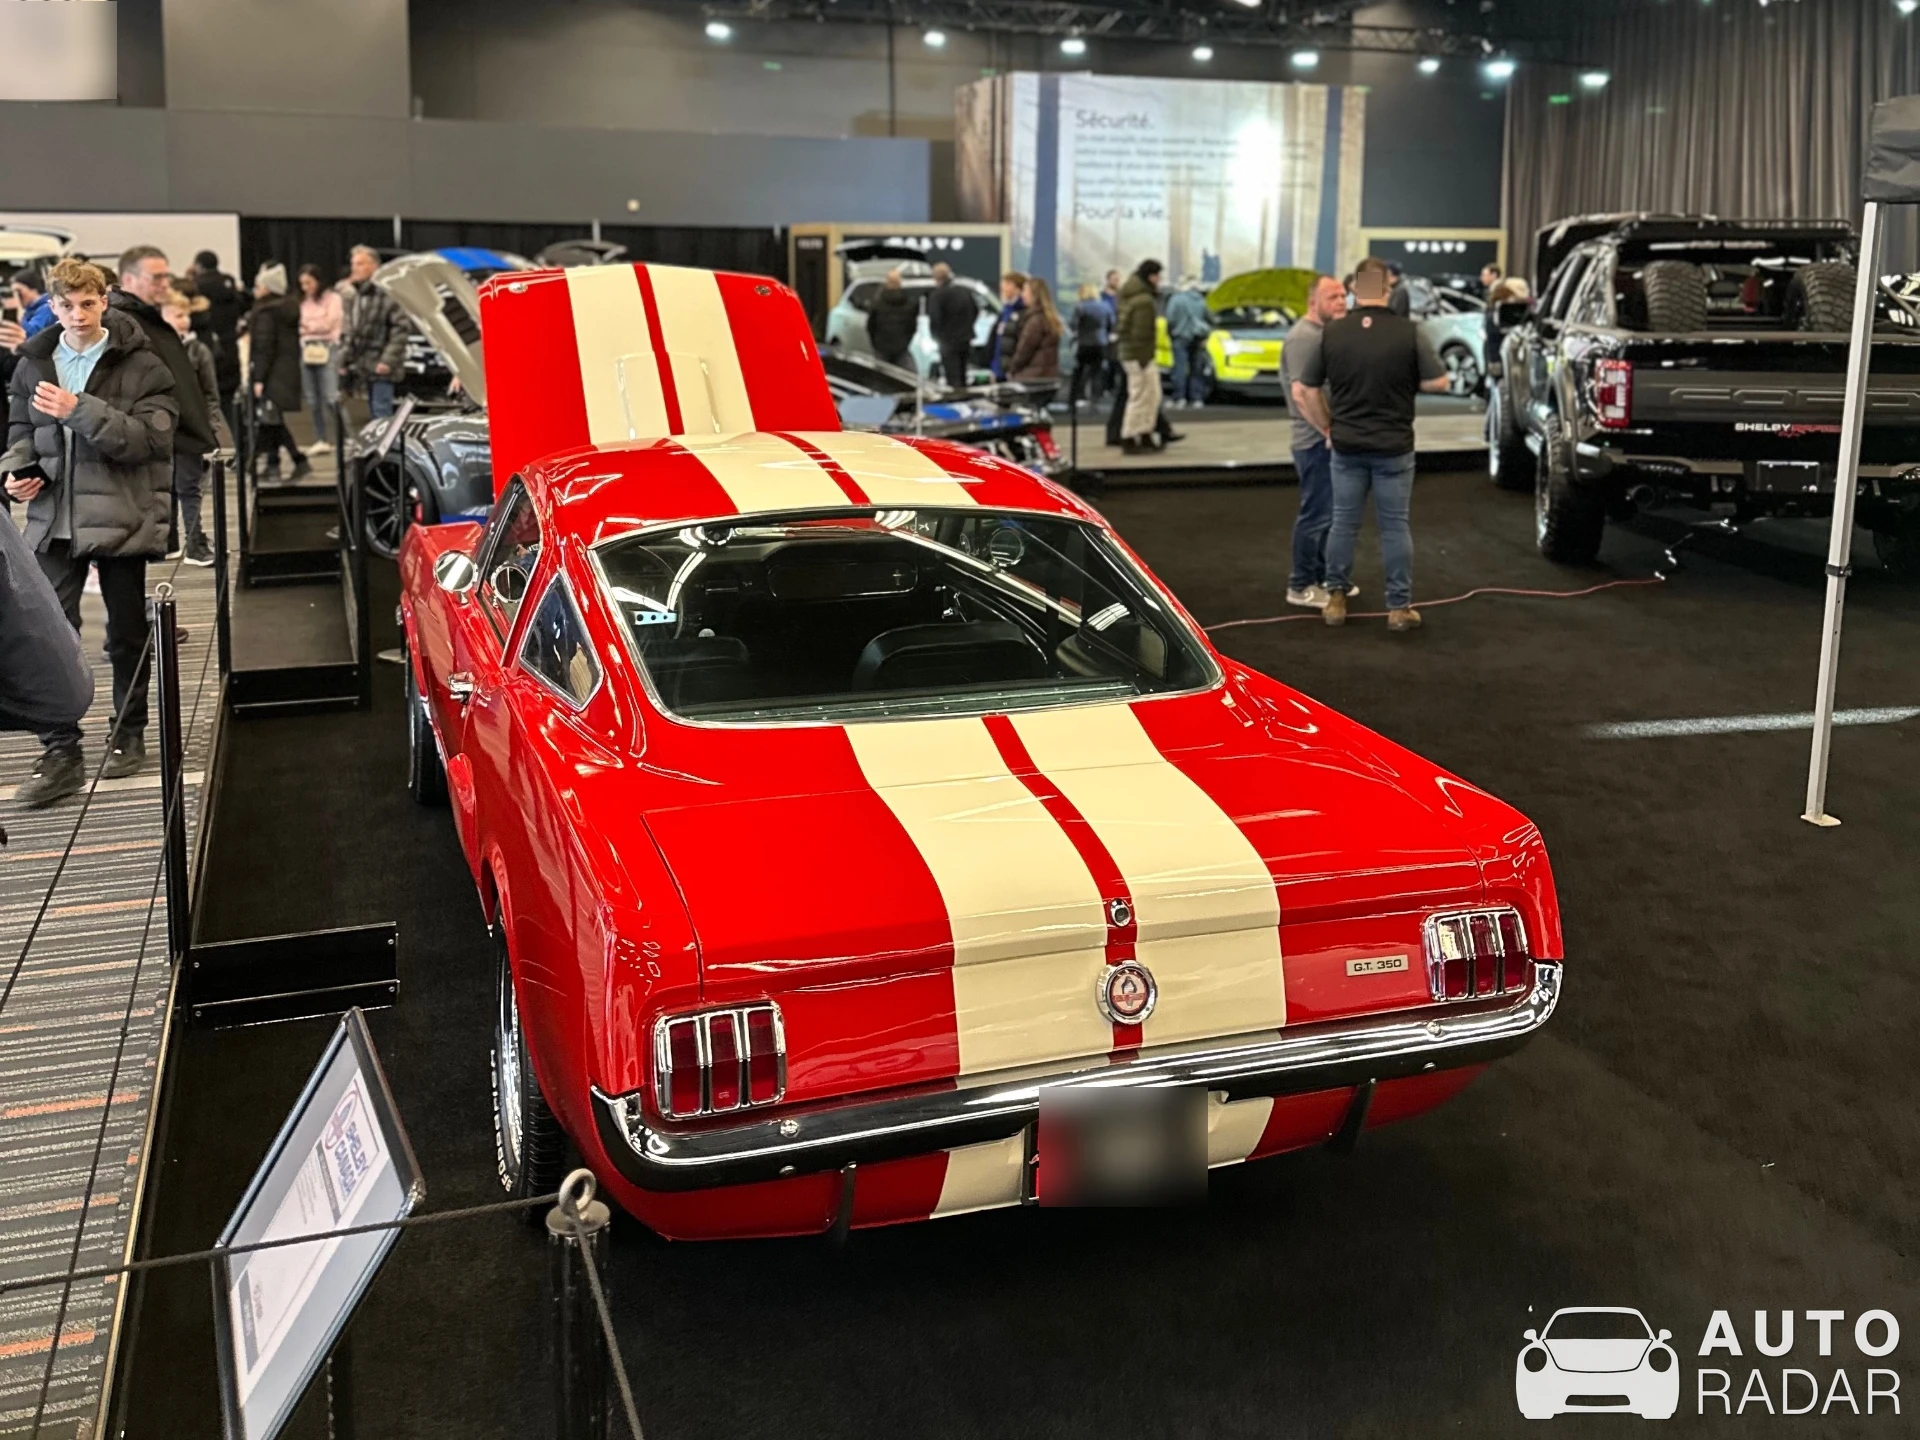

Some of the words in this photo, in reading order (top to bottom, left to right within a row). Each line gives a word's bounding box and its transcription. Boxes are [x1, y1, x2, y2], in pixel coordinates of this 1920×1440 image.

[1075, 202, 1115, 219] Pour
[1404, 240, 1466, 253] VOLVO
[1735, 422, 1791, 432] SHELBY
[1377, 958, 1402, 970] 350
